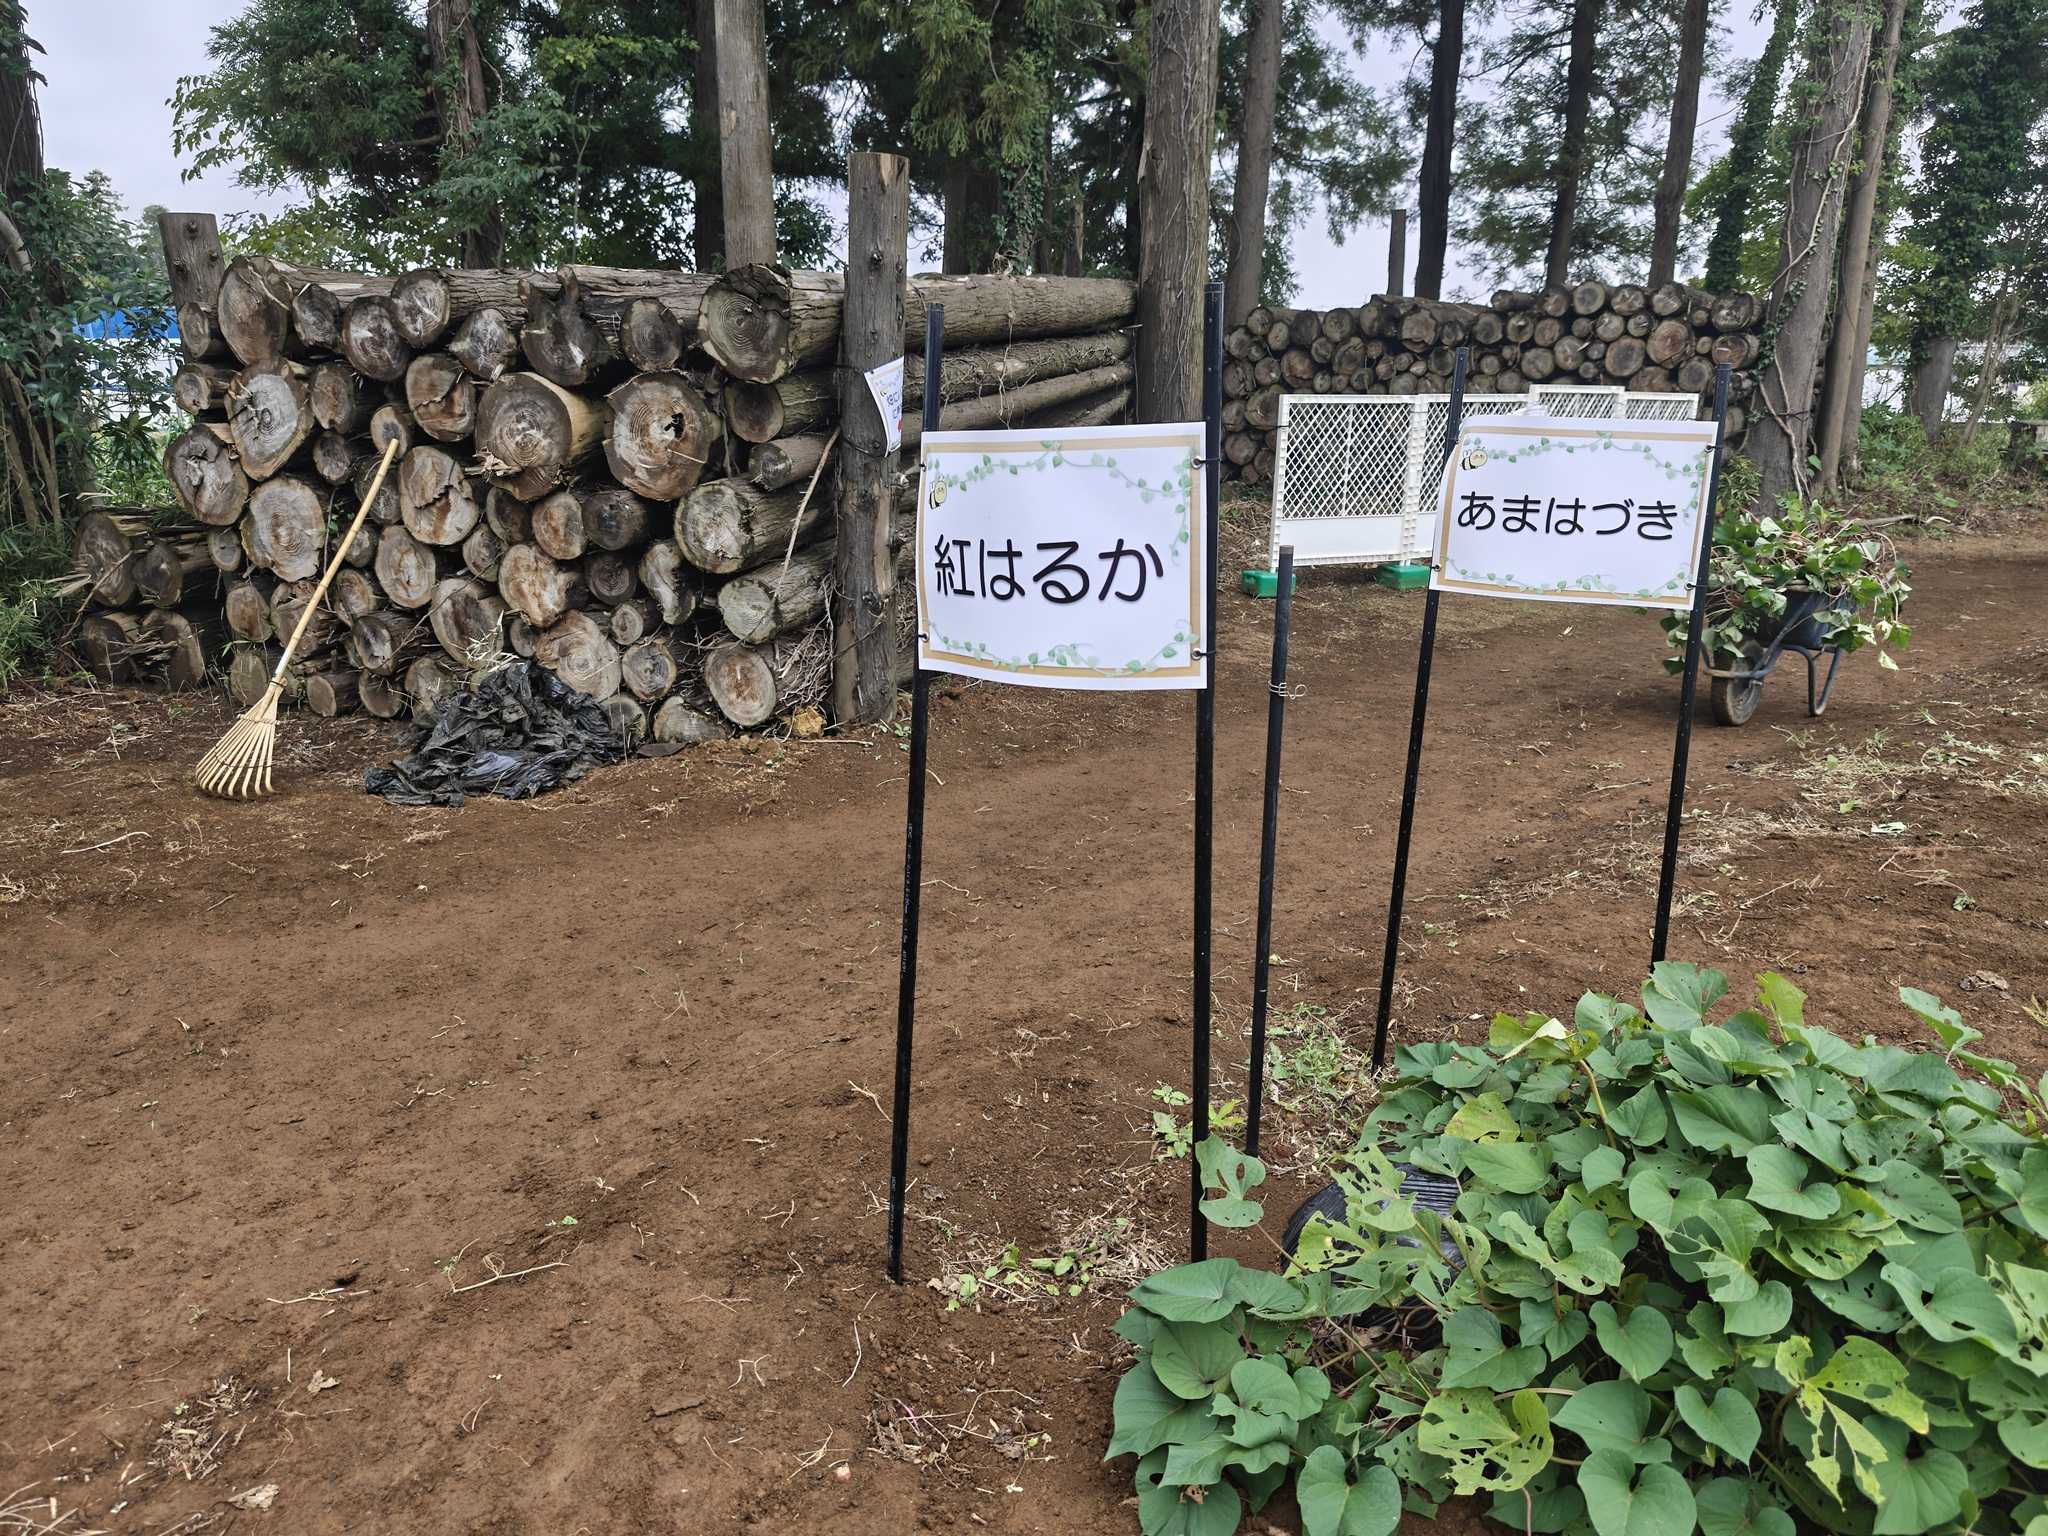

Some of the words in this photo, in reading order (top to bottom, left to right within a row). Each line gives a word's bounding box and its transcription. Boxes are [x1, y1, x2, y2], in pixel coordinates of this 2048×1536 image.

[1457, 491, 1678, 541] あまはづき
[934, 534, 1164, 604] 紅はるか
